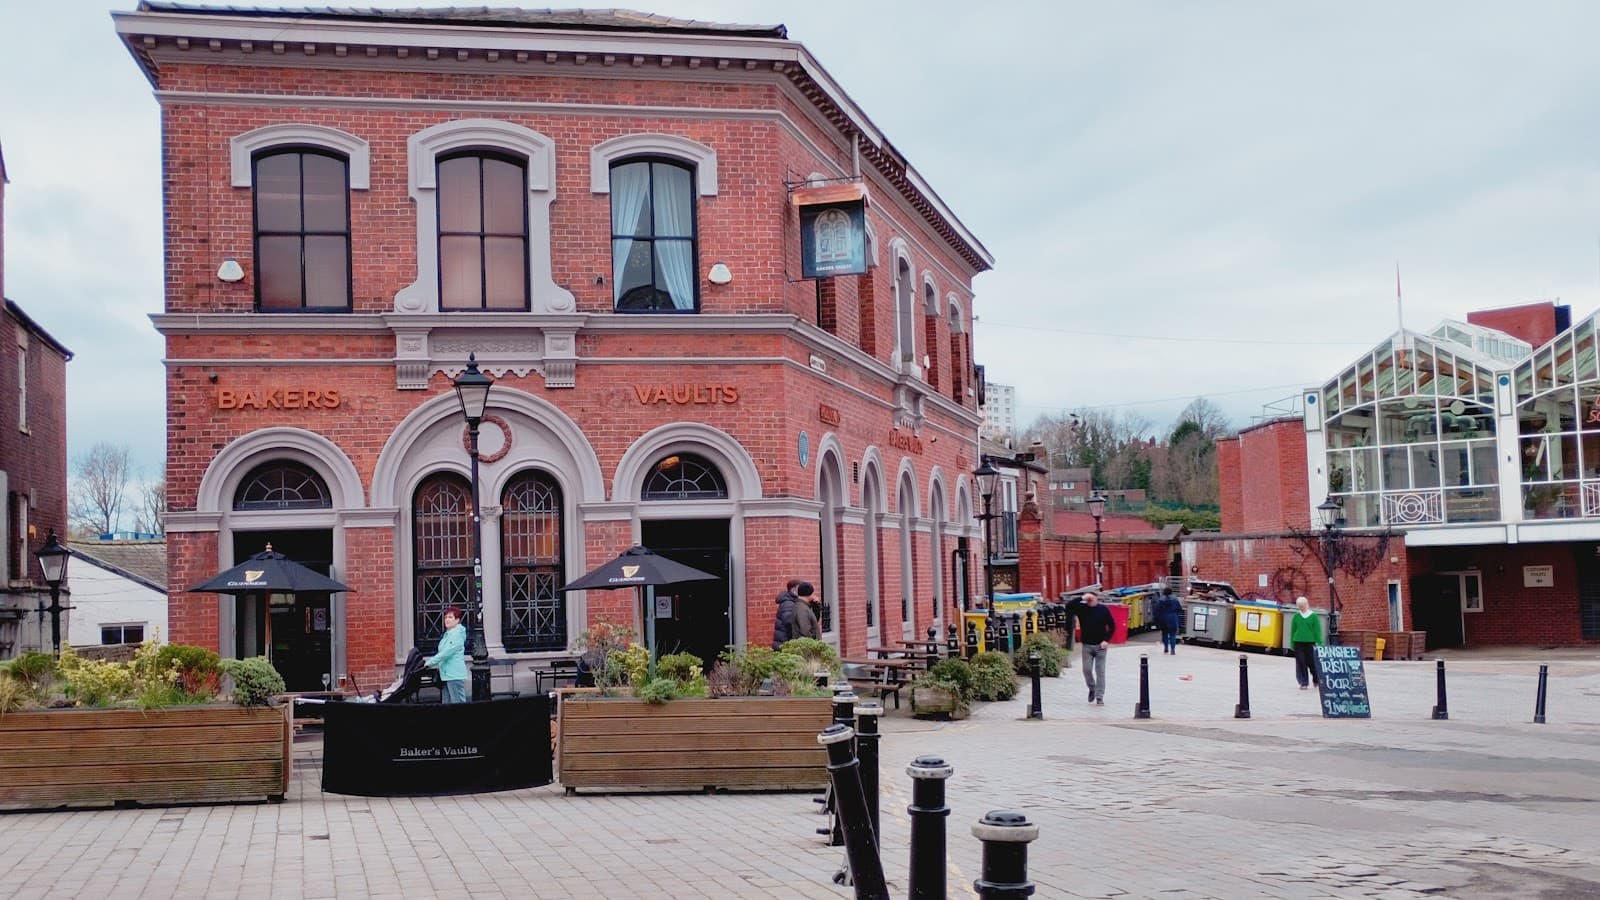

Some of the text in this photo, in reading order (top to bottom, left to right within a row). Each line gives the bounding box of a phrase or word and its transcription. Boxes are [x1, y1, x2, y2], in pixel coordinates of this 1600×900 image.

[218, 383, 738, 410] BAKERS VAULTS
[1317, 646, 1358, 658] BANSHEE
[400, 745, 478, 757] Baker's Vaults
